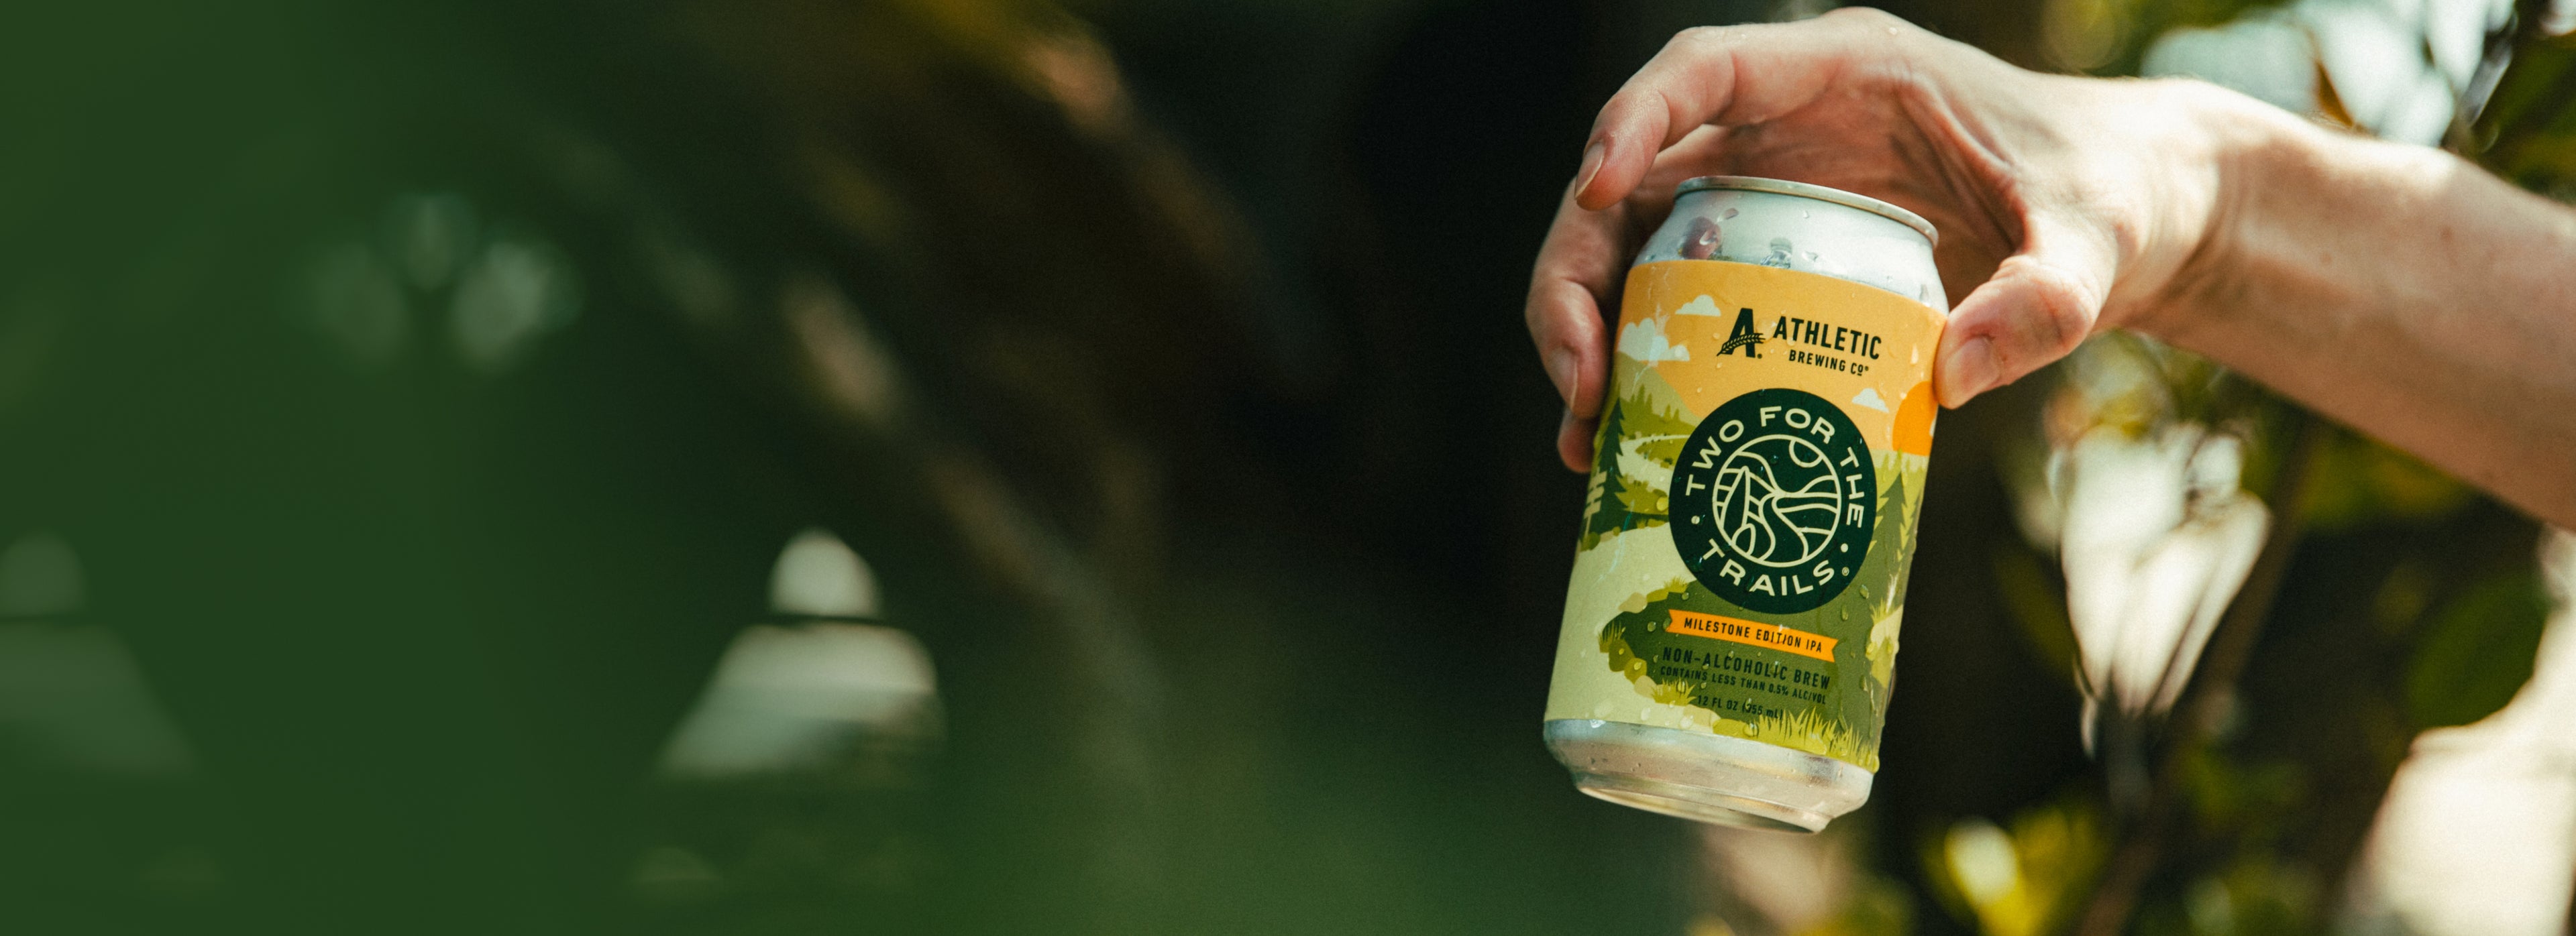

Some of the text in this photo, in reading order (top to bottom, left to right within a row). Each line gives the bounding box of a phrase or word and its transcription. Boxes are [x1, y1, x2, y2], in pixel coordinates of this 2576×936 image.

[1773, 316, 1882, 359] ATHLETIC
[1789, 349, 1846, 371] BREWING
[1686, 406, 1865, 528] TWO FOR THE
[1684, 618, 1822, 653] MILESTONE EDITION IPA
[1660, 666, 1826, 705] CONTAINS LESS THAN 0.5% ALC/VOL
[1662, 647, 1830, 689] NON-ALCOHOLIC BREW
[1698, 695, 1709, 706] 12
[1712, 697, 1722, 708] FL
[1726, 700, 1738, 711] OZ
